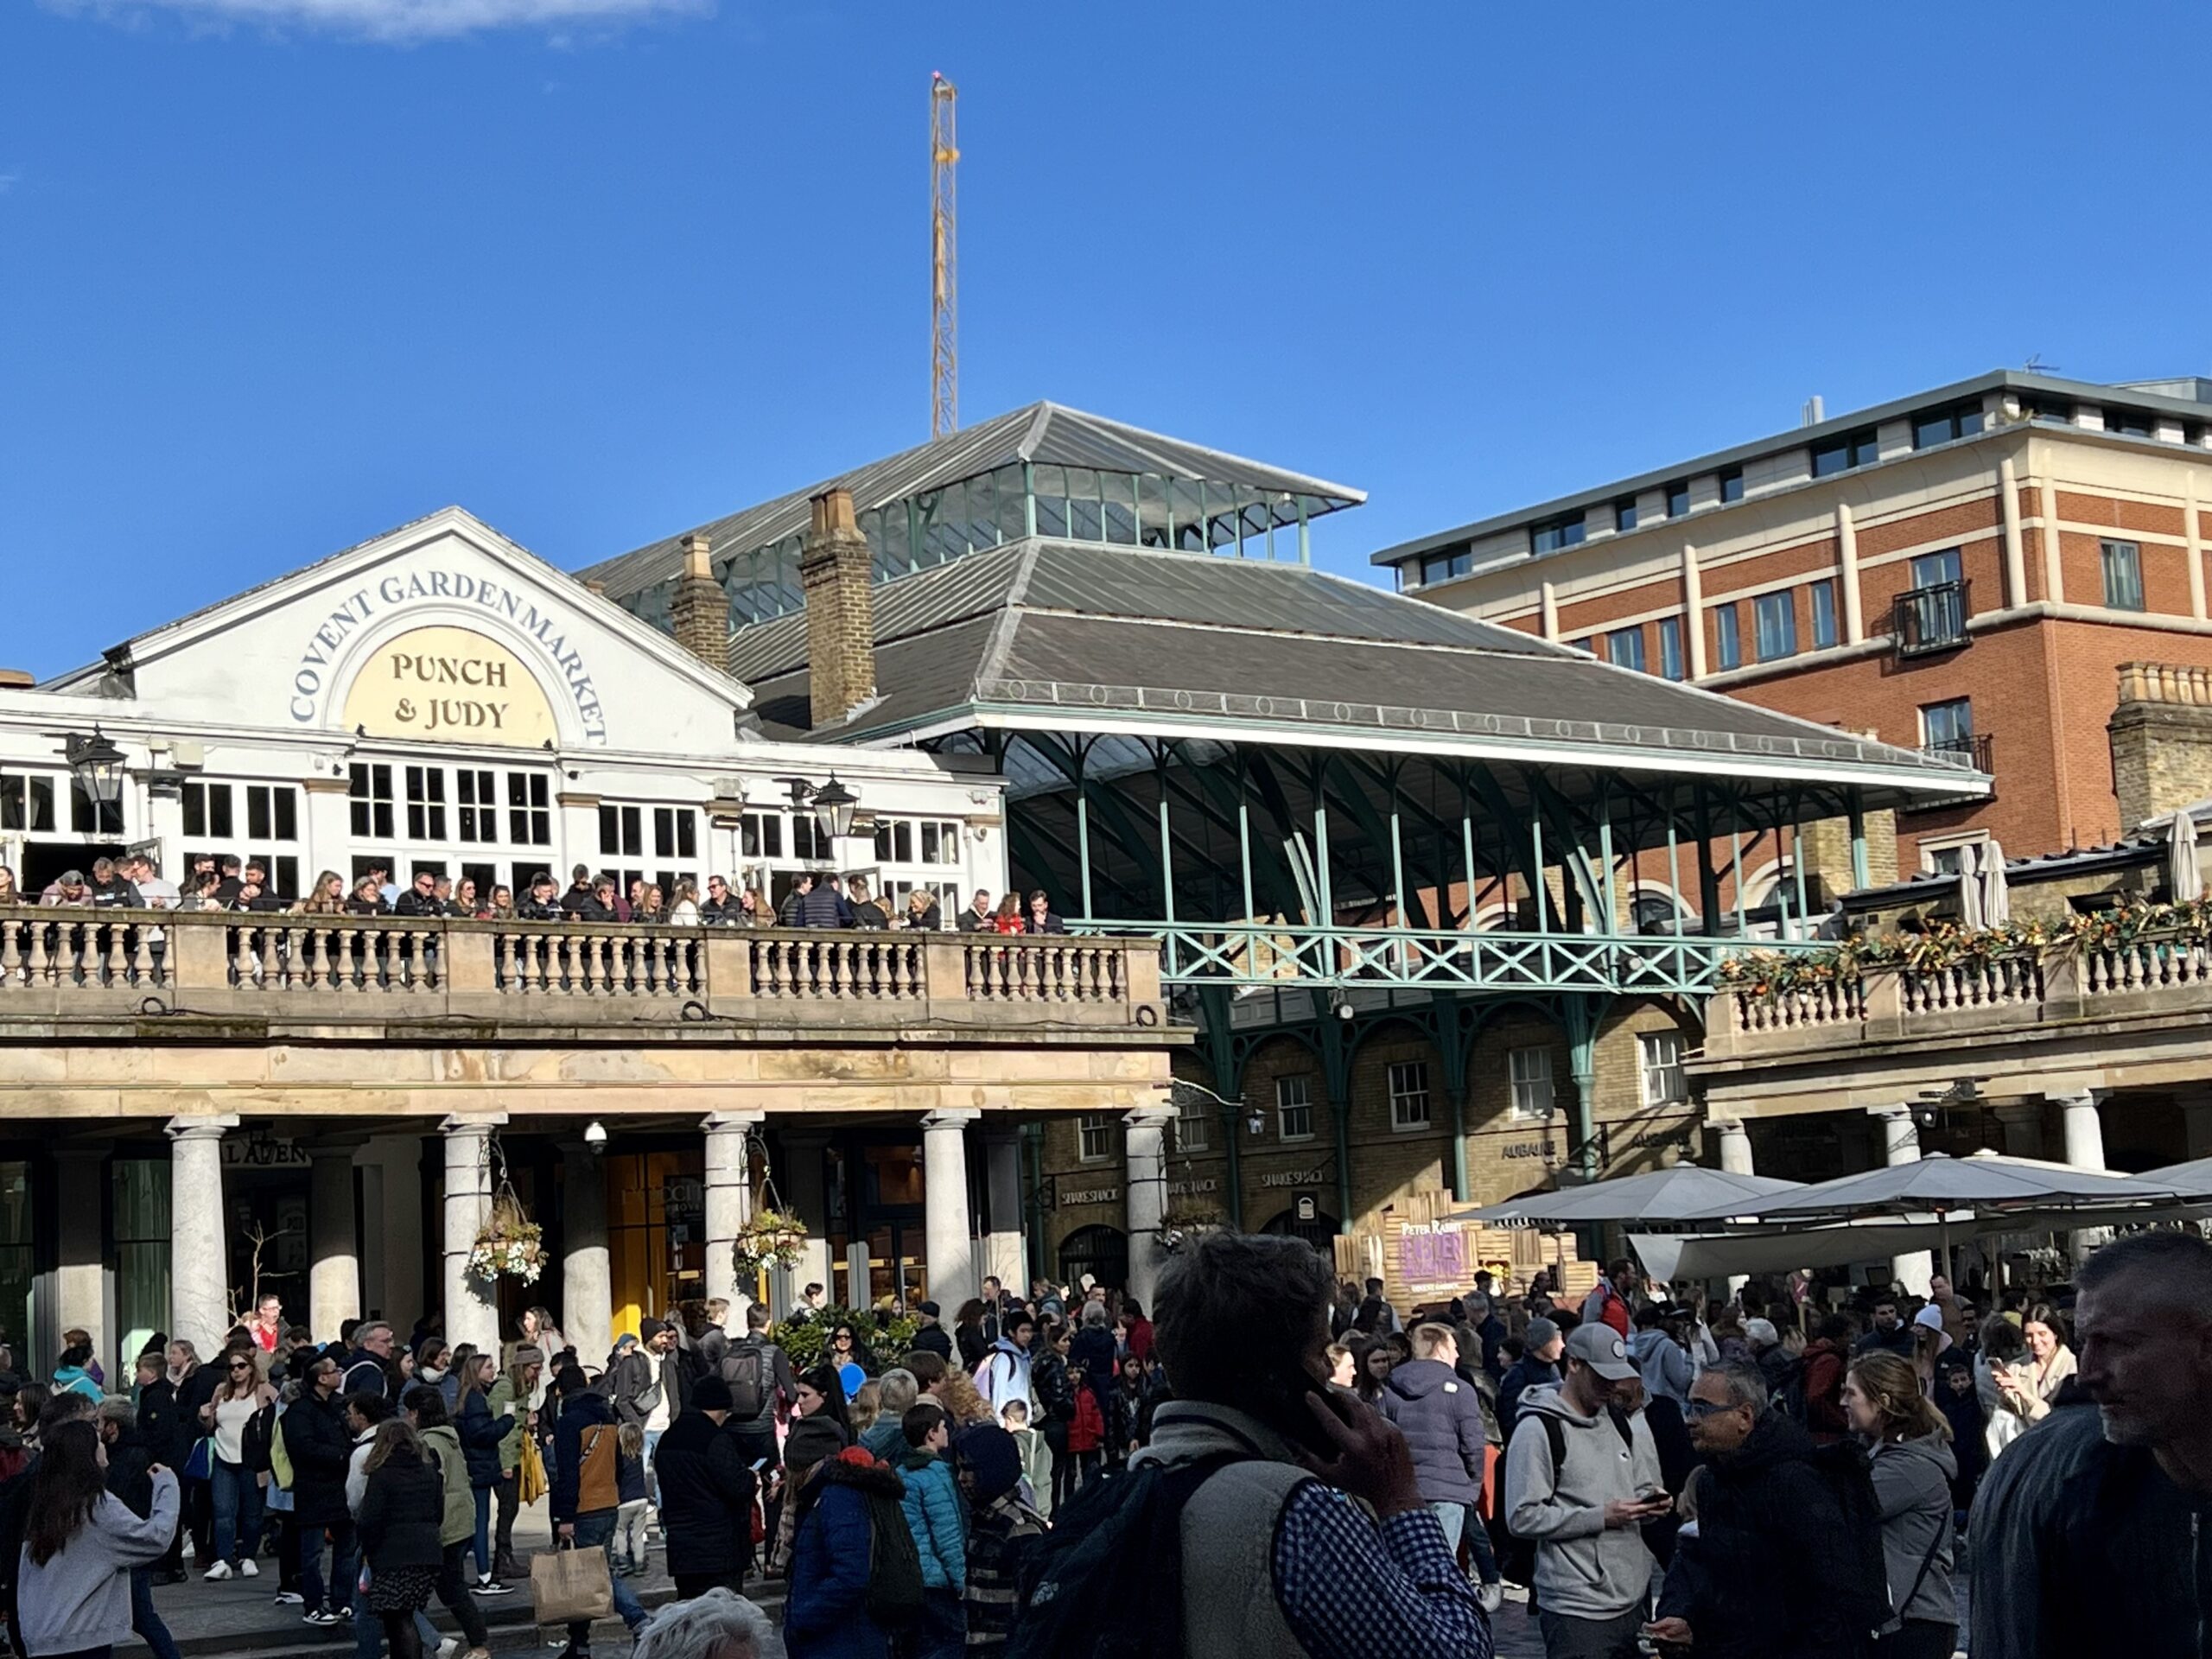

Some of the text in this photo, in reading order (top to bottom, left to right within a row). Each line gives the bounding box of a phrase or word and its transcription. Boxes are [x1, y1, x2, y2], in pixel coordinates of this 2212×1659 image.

[290, 571, 607, 745] COVENT GARDEN MARKET
[391, 653, 508, 688] PUNCH
[395, 698, 510, 731] & JUDY
